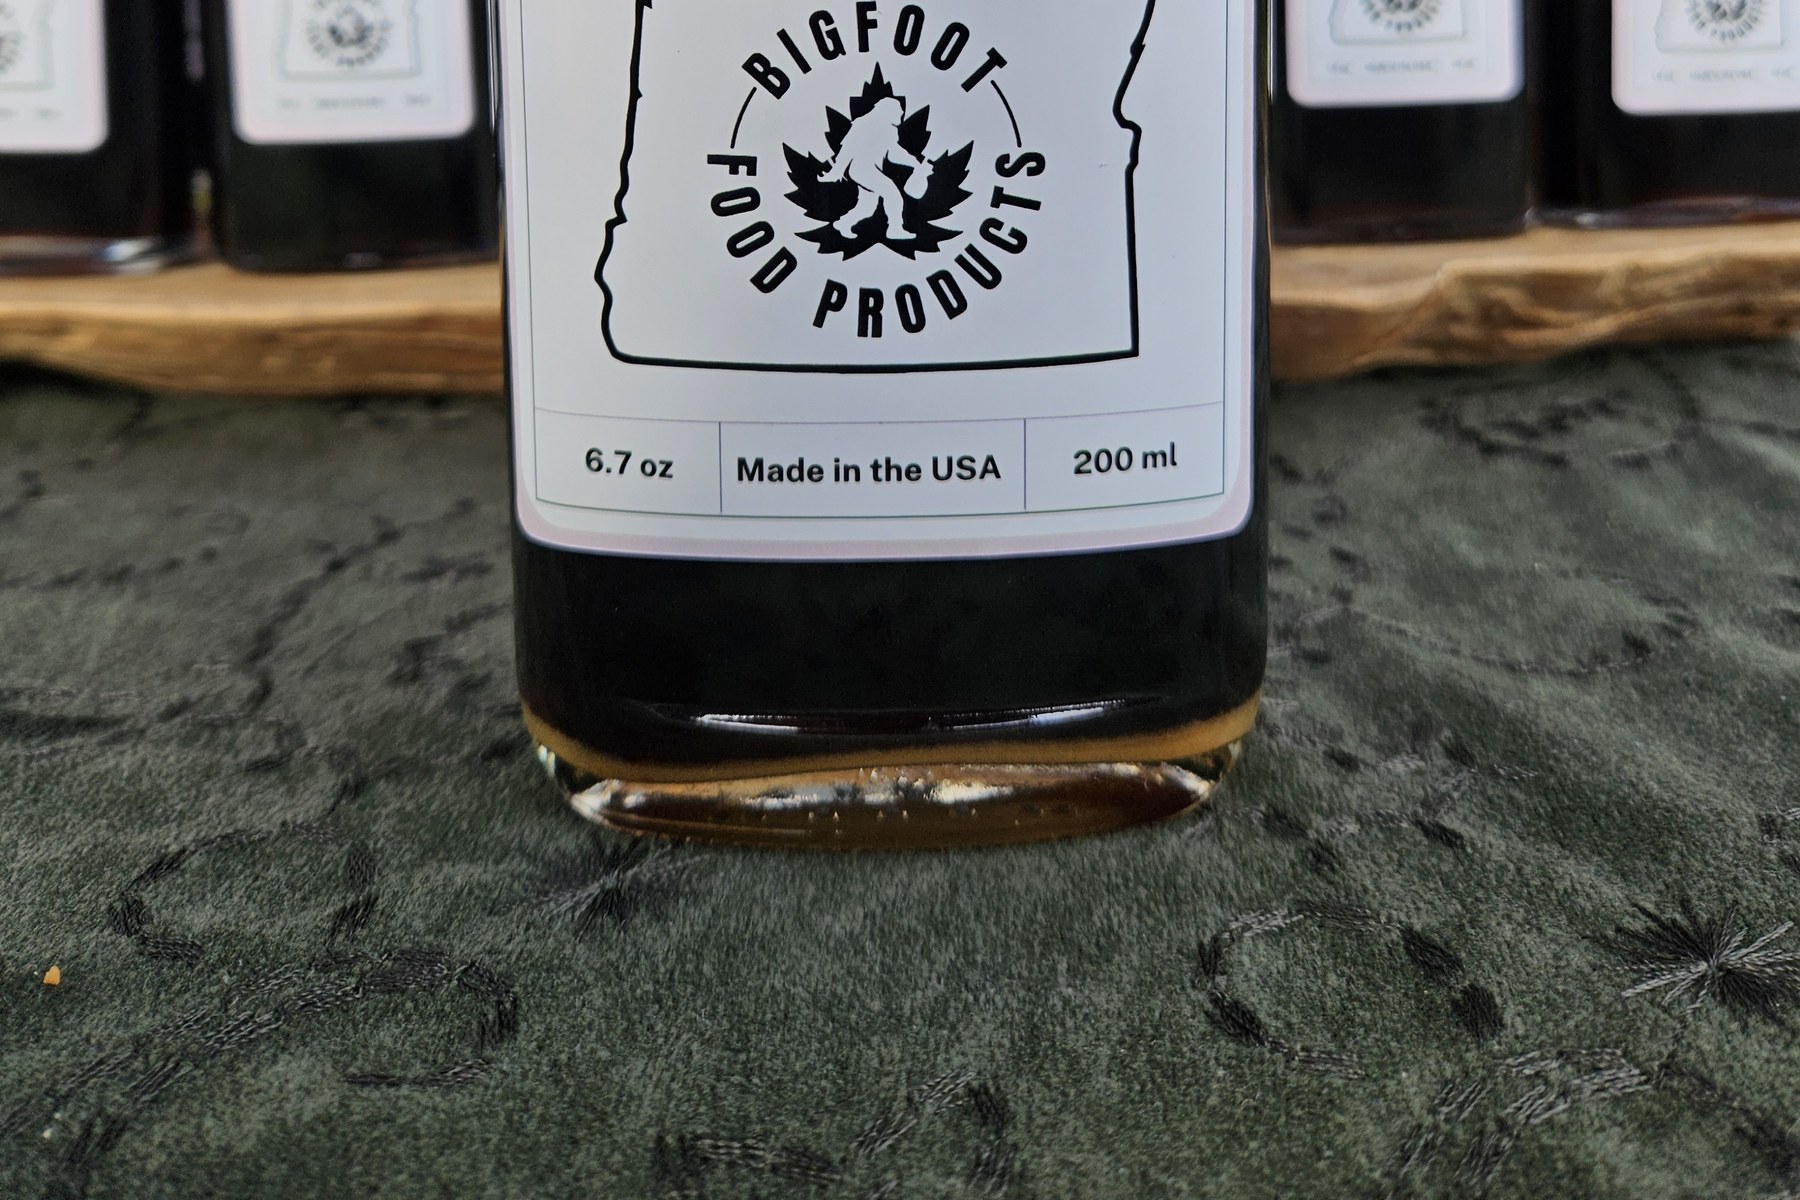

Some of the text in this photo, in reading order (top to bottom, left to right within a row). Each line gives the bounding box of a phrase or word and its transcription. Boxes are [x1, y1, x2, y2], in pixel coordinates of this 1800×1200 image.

[742, 1, 1008, 100] BIGFOOT
[707, 152, 1046, 338] FOOD PRODUCTS
[585, 447, 674, 479] 6.7 oz
[737, 454, 1002, 483] Made in the USA
[1073, 441, 1178, 475] 200 ml
